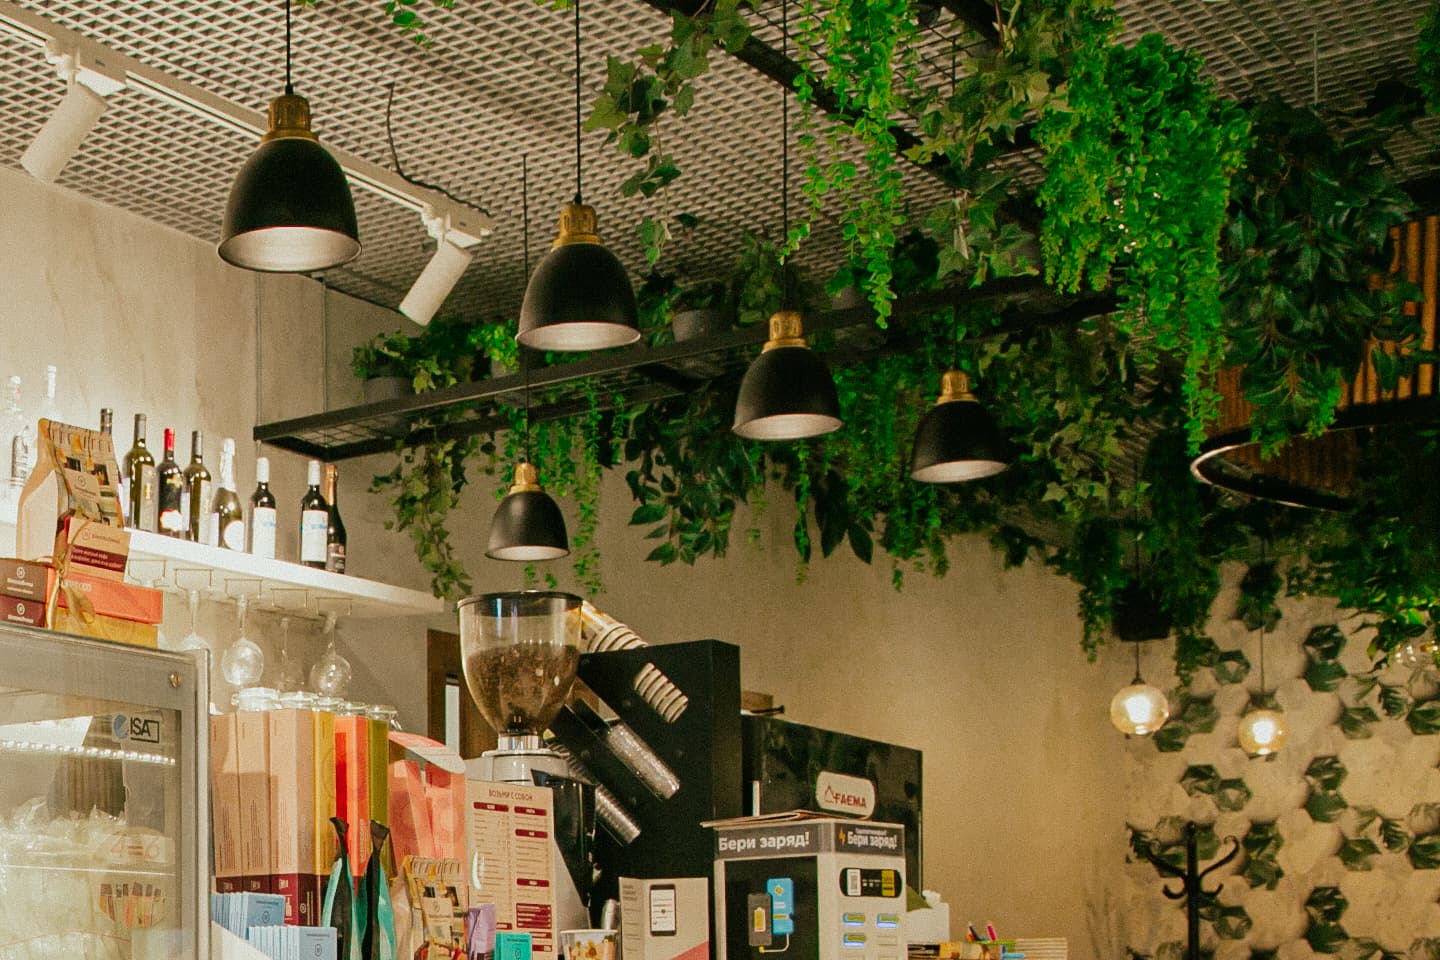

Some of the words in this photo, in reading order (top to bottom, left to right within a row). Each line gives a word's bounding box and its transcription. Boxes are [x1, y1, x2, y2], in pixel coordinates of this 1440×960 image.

[130, 717, 151, 737] ISA
[833, 793, 867, 809] FAEMA
[718, 837, 756, 852] Бери
[760, 831, 810, 849] заряд!
[847, 831, 869, 848] Бери
[870, 834, 897, 849] заряд!
